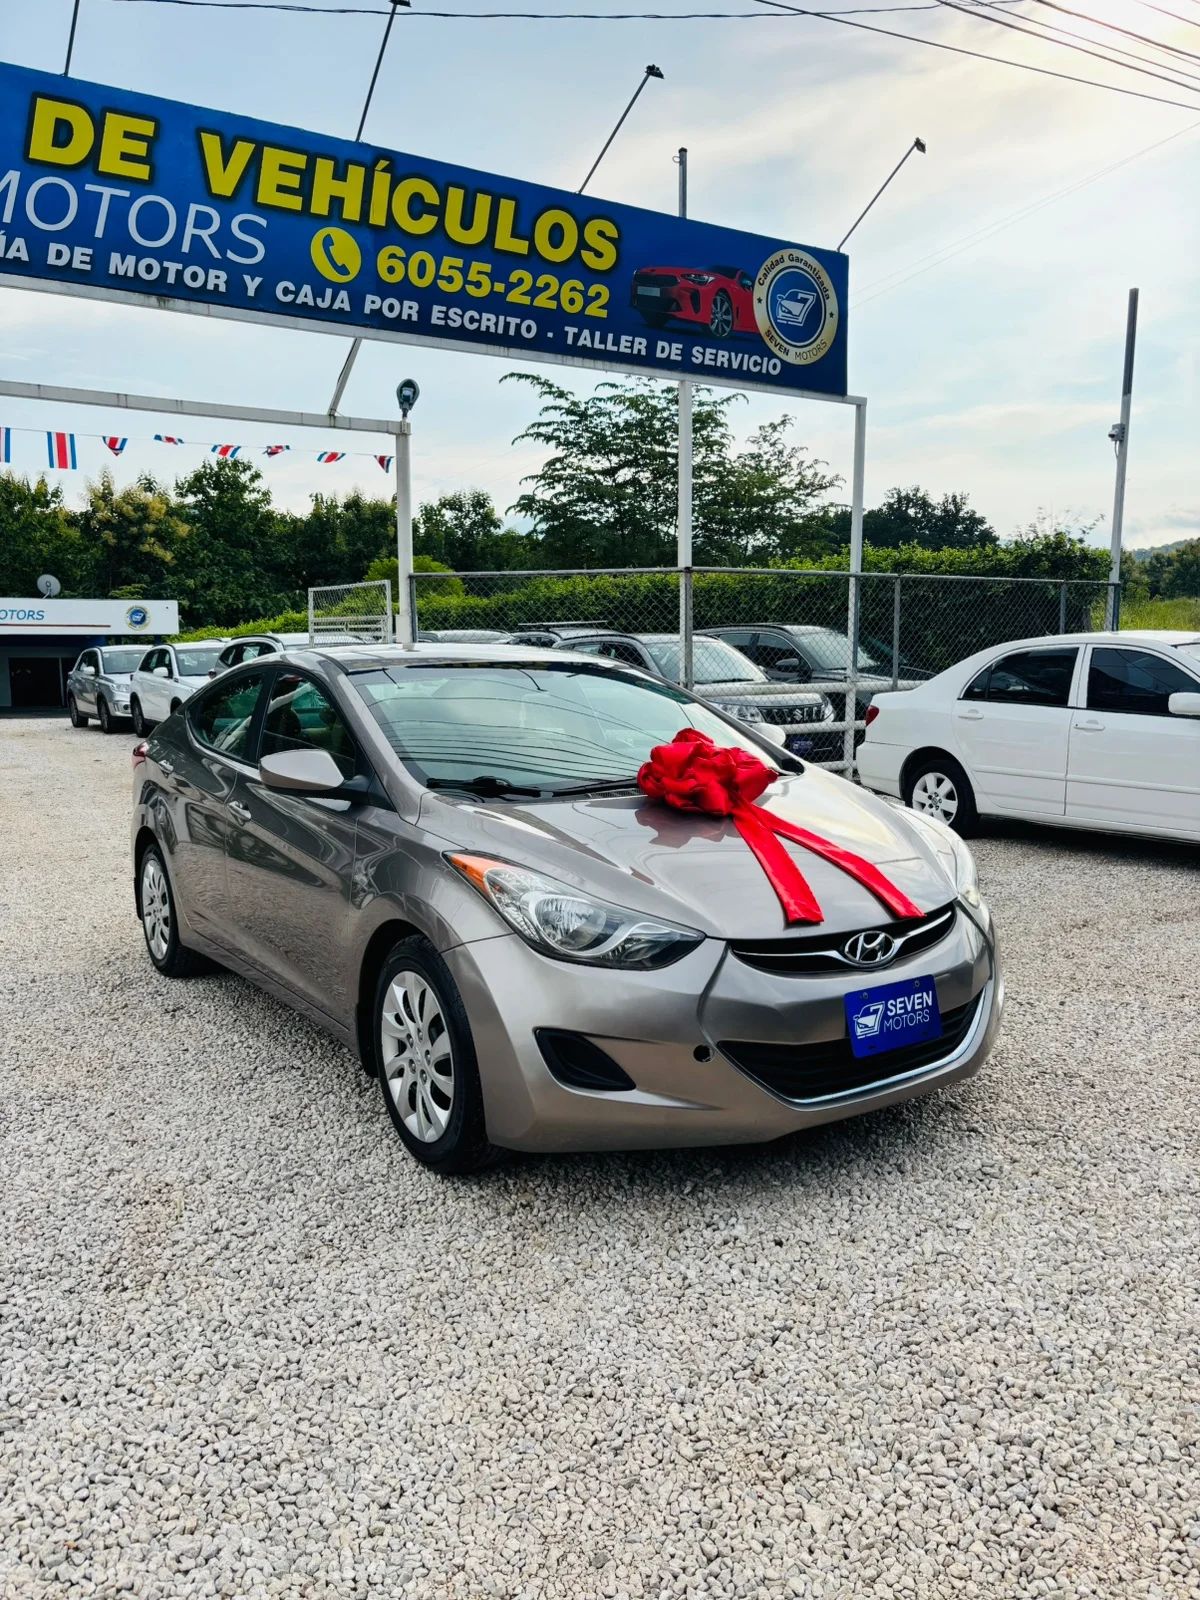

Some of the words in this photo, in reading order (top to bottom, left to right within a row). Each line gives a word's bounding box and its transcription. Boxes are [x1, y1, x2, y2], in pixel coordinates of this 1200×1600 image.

[29, 97, 155, 181] DE
[200, 132, 618, 271] VEHÍCULOS
[377, 246, 610, 318] 6055-2262
[757, 254, 785, 287] Calidad
[788, 253, 830, 300] Garantizada
[47, 242, 94, 271] DE
[108, 251, 228, 293] MOTOR
[243, 274, 264, 297] Y
[276, 280, 351, 312] CAJA
[363, 293, 420, 322] POR
[431, 304, 538, 339] ESCRITO
[564, 325, 648, 356] TALLER
[656, 340, 684, 361] DE
[691, 345, 782, 376] SERVICIO
[764, 329, 790, 356] SEVEN
[794, 339, 828, 361] MOTORS
[883, 1008, 930, 1033] MOTORS
[887, 990, 932, 1016] SEVEN
